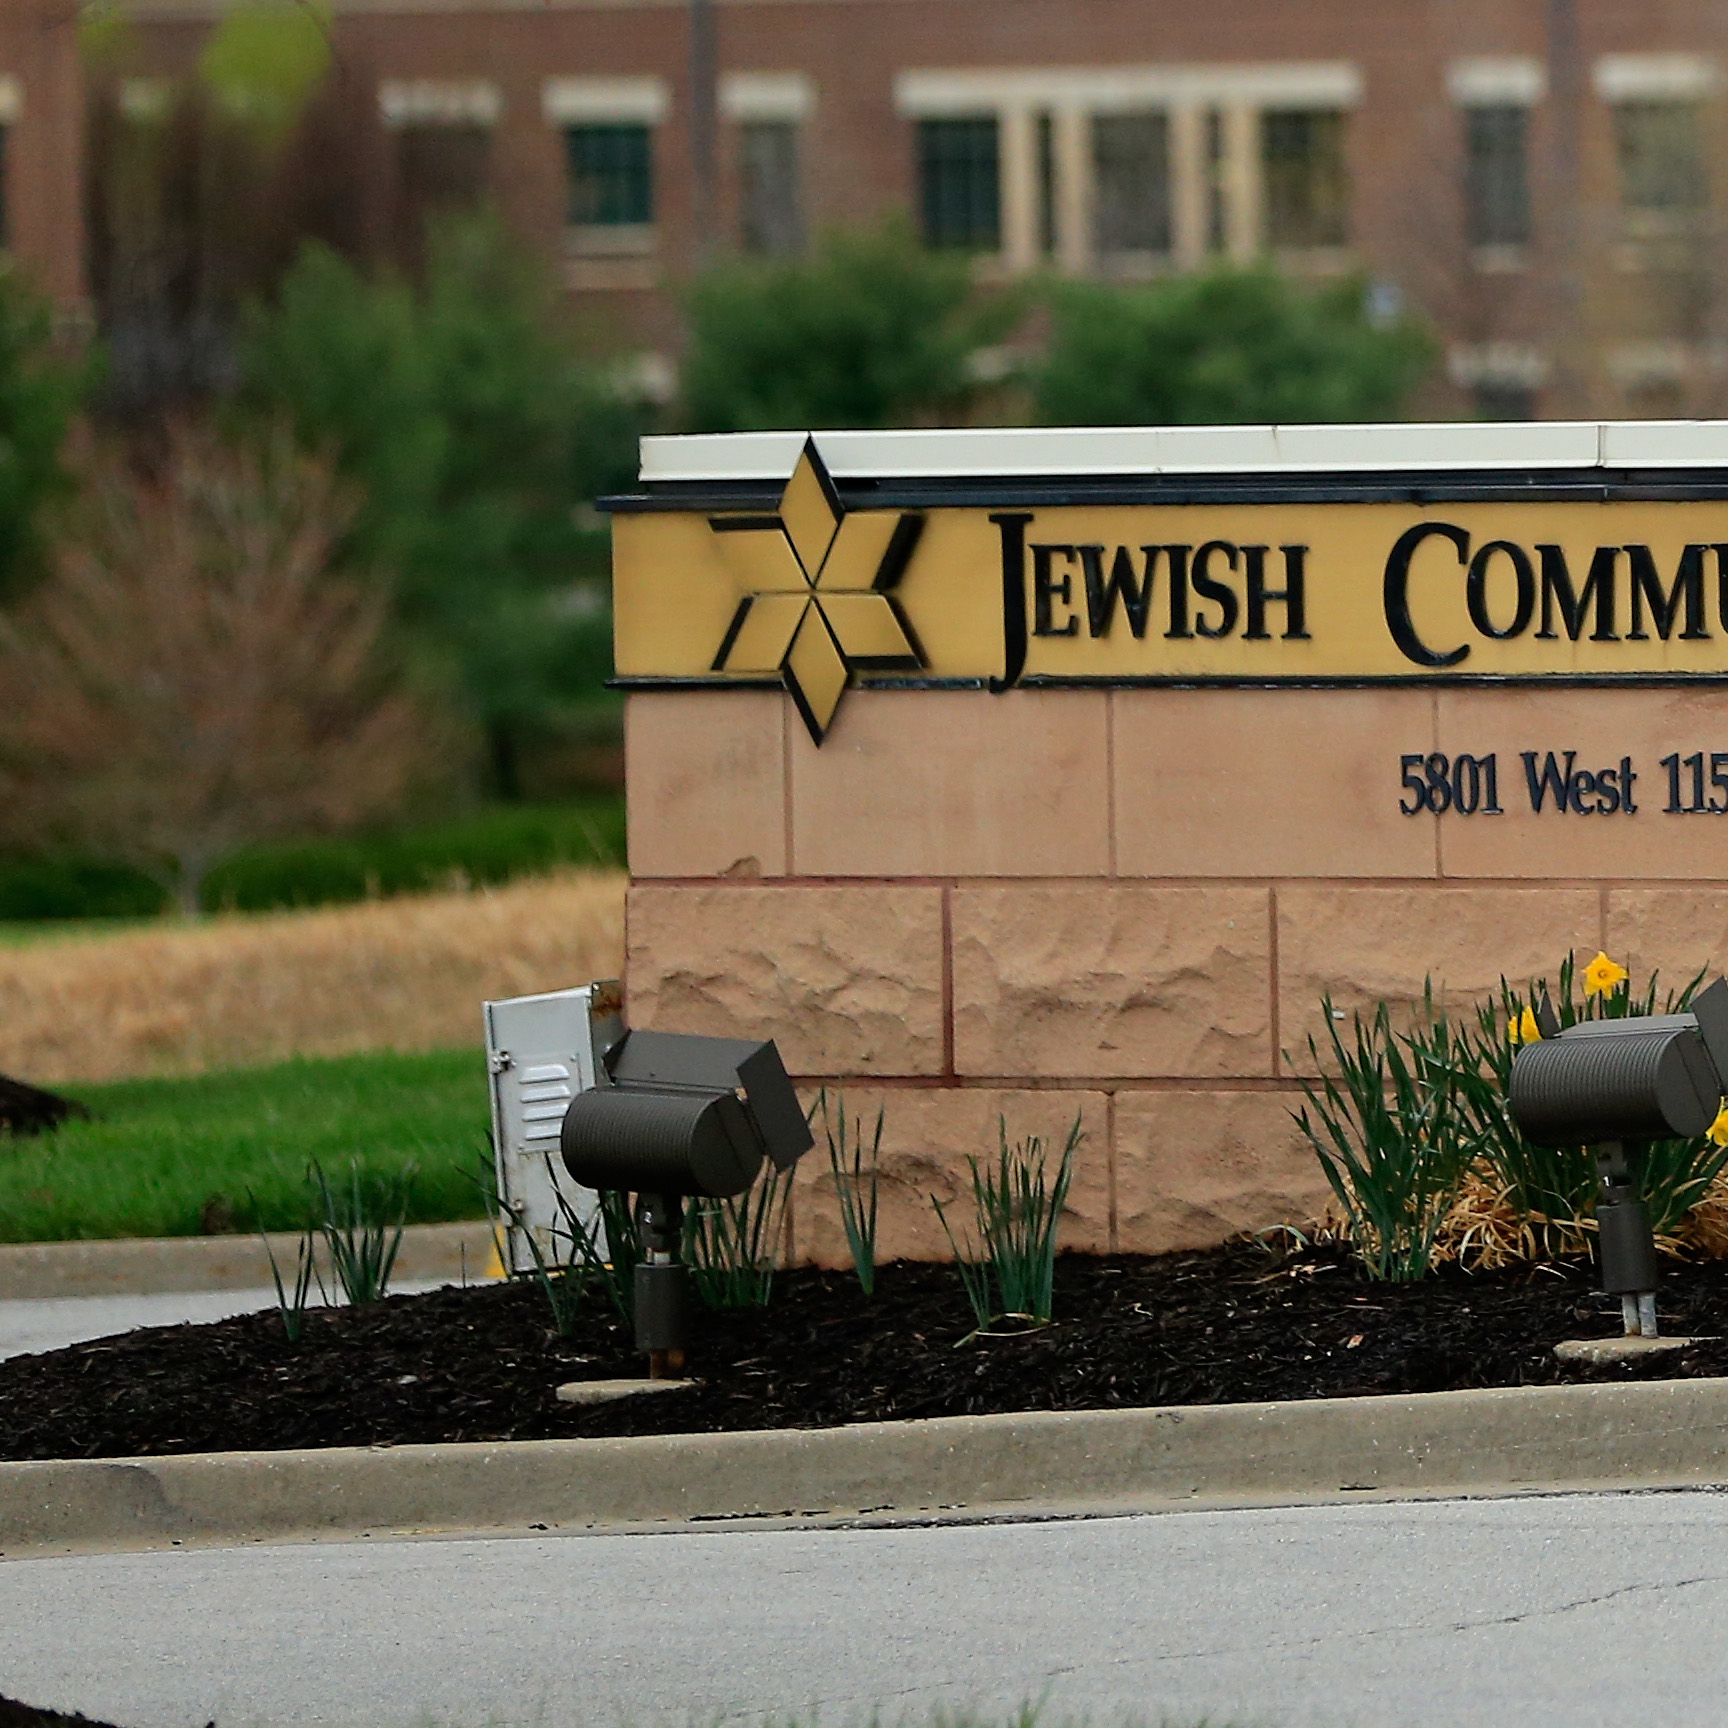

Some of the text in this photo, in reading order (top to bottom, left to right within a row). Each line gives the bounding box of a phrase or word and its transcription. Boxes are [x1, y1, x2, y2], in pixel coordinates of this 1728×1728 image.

[989, 513, 1312, 694] JEWISH
[1399, 752, 1504, 816] 5801
[1519, 750, 1637, 816] West
